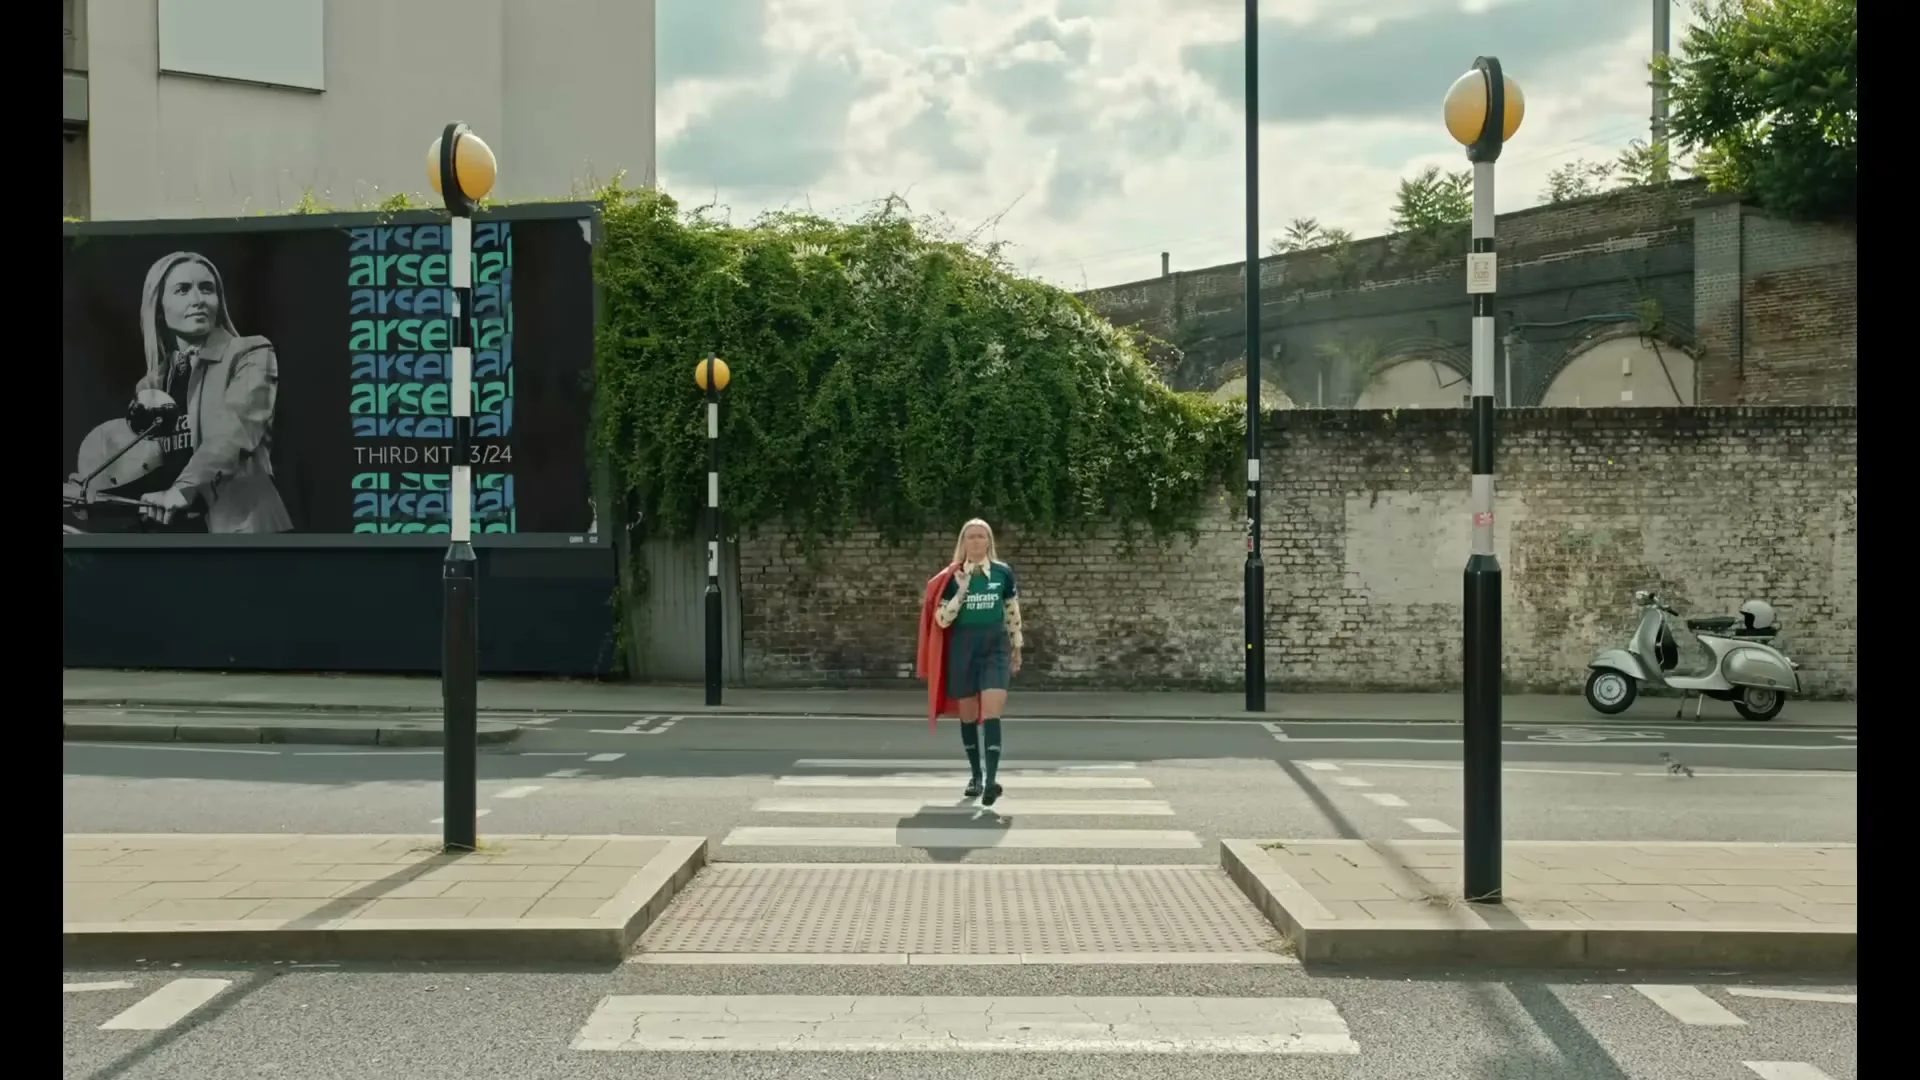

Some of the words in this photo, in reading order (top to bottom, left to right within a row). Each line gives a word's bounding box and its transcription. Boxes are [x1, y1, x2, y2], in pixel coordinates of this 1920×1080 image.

[353, 446, 418, 464] THIRD
[424, 446, 453, 464] KIT
[469, 445, 512, 464] 3/24
